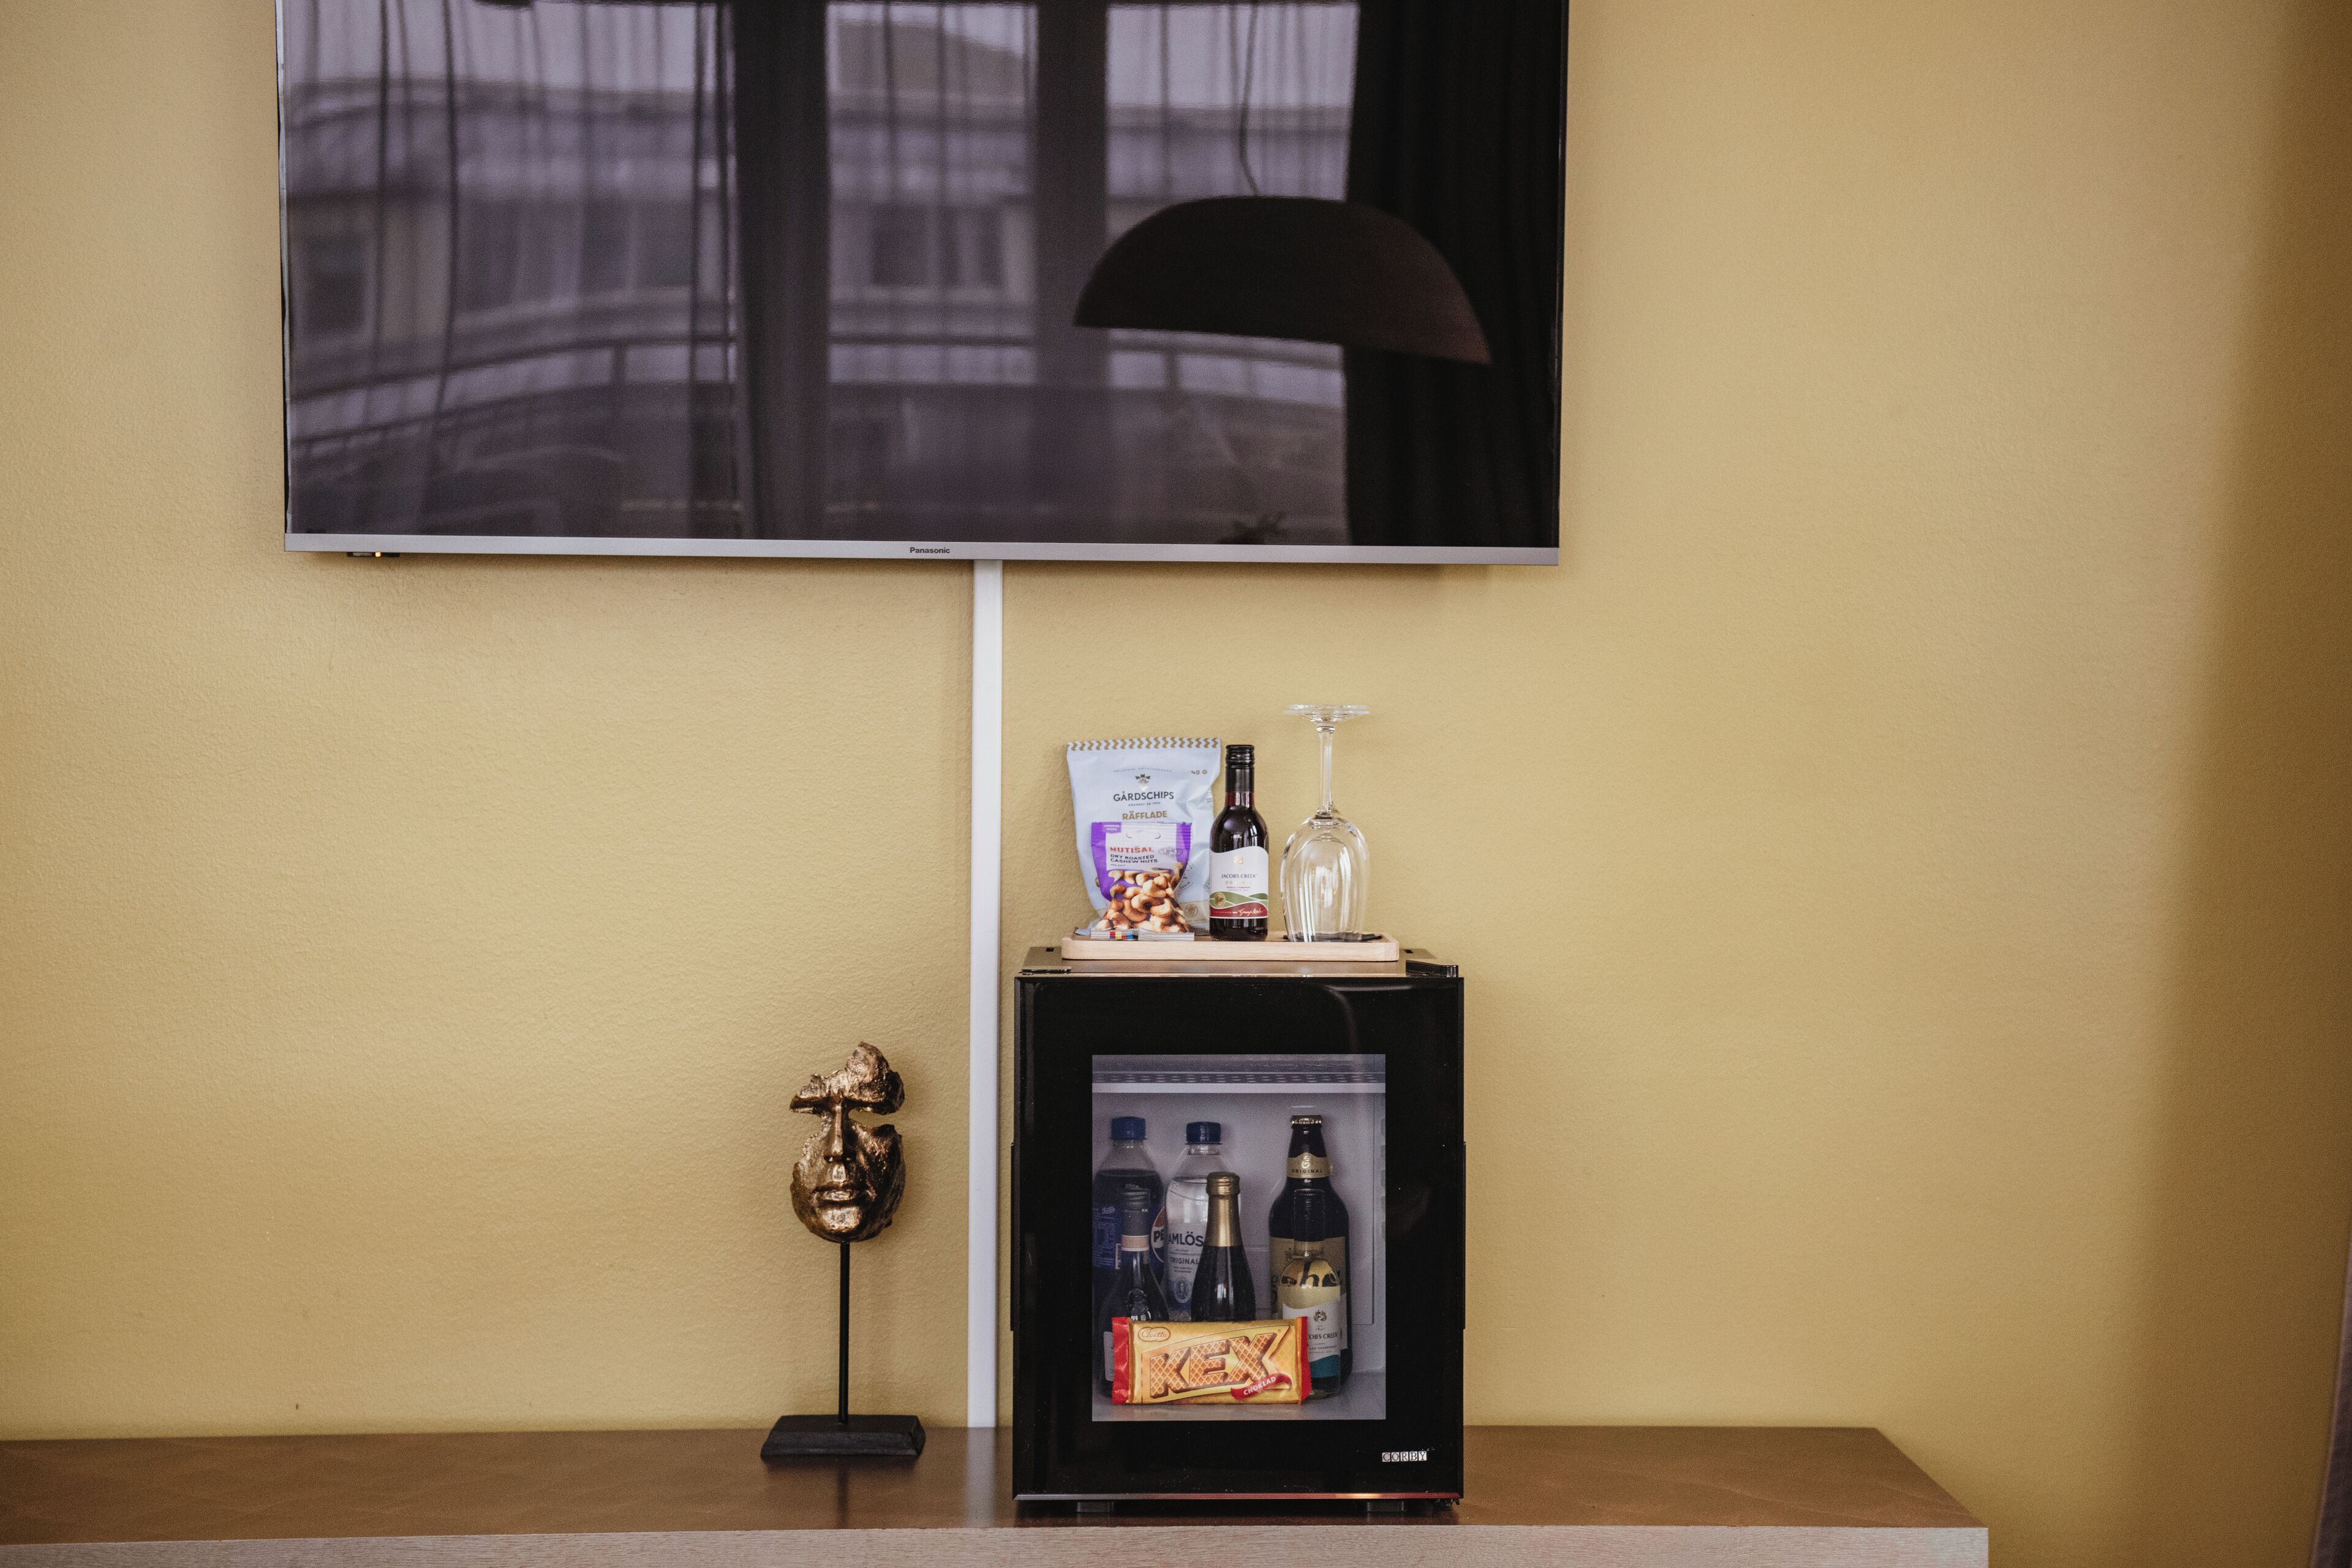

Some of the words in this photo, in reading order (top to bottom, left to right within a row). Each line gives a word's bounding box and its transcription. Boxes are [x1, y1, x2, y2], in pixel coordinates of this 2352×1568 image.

[1113, 791, 1174, 802] GÅRDSCHIPS
[1122, 811, 1167, 820] RÄFFLADE
[1141, 1329, 1167, 1338] Cloetta
[1150, 1332, 1279, 1399] KEX
[1243, 1376, 1277, 1396] CHOKLAD
[1382, 1451, 1427, 1462] CORBY
